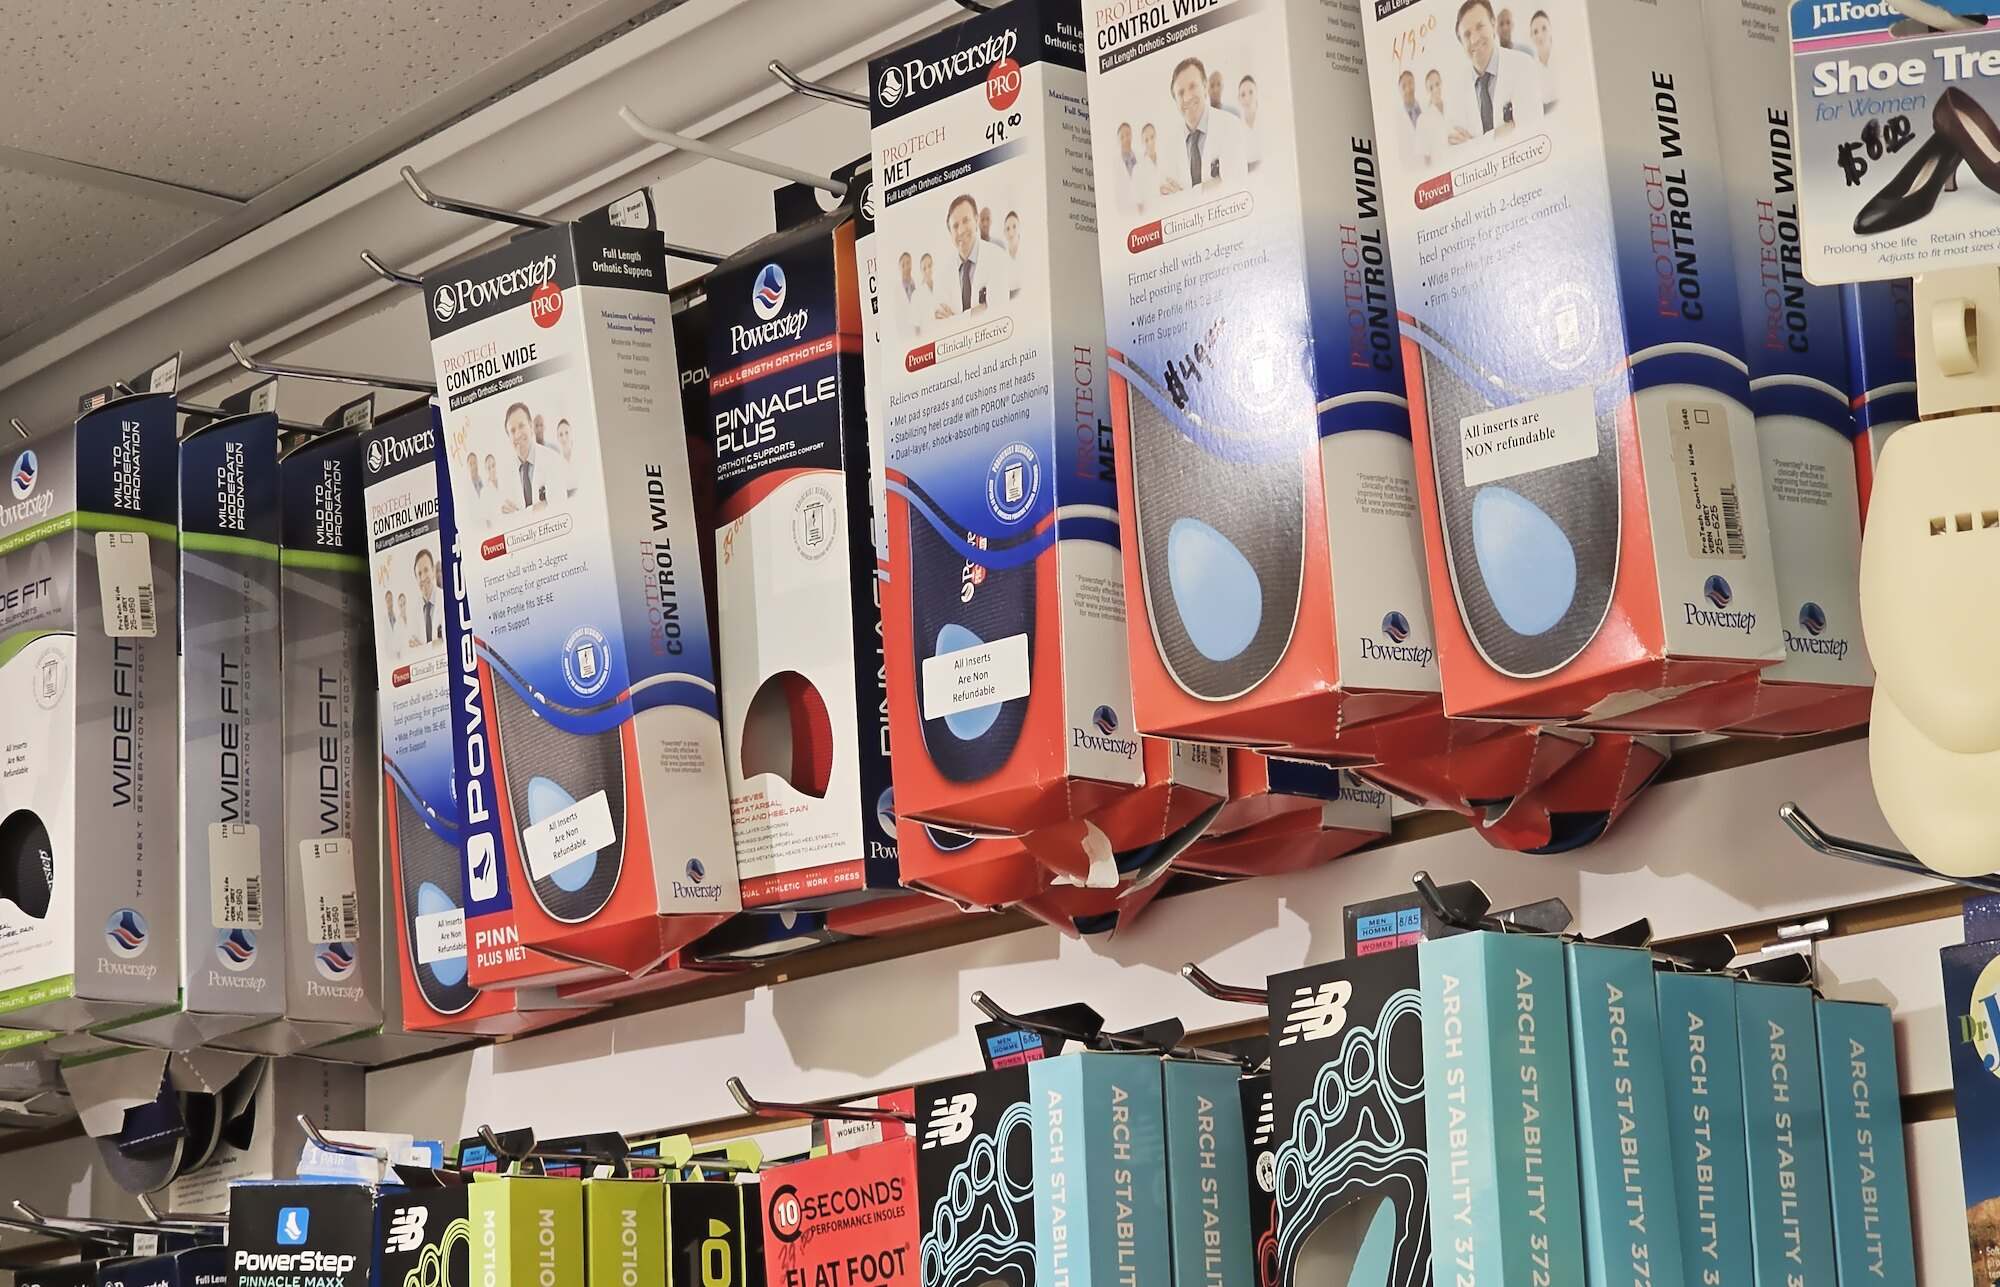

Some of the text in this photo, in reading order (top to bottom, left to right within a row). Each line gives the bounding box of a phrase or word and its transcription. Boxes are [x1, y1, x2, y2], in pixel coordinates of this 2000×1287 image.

[1098, 4, 1170, 51] CONTROL
[904, 28, 1018, 98] Powerstep
[1101, 24, 1198, 70] Full Length Orthotic Supports
[988, 70, 1020, 100] PRO
[1813, 46, 2000, 97] Shoe Tre
[1816, 95, 1926, 122] for Women
[882, 127, 946, 165] PROTECH
[884, 158, 912, 186] MET
[886, 163, 972, 204] Full Length Orthotic Supports
[1650, 70, 1703, 322] CONTROL WIDE
[602, 248, 641, 263] Full Length
[1351, 136, 1393, 373] CONTROL WIDE
[1642, 163, 1680, 319] PROTECH
[1823, 244, 1868, 255] Prolong
[1871, 240, 1898, 250] shoe
[1900, 237, 1918, 247] life
[1930, 229, 1966, 244] Retain
[1878, 243, 1994, 264] Adjusts to fit most sizes
[592, 261, 652, 278] Orthotic Supports
[1127, 239, 1245, 287] Firmer shell with 2-degree
[456, 255, 557, 314] Powerstep
[1339, 224, 1370, 369] PROTECH
[532, 293, 562, 318] PRO
[730, 309, 808, 355] Powerstep
[443, 341, 498, 372] PROTECH
[446, 343, 538, 392] CONTROL WIDE
[712, 340, 833, 389] FULL LENGTH ORTHOTICS
[908, 351, 934, 368] Proven
[936, 335, 973, 356] Clinically
[889, 349, 1038, 408] Relieves metatarsal, heel and arch pain
[715, 375, 836, 436] PINNACLE
[894, 371, 1035, 427] Met pad spreads and cushions met heads
[716, 418, 777, 458] PLUS
[895, 408, 1030, 461] Dual-layer, shock-absorbing cushioning
[1464, 412, 1540, 441] All inserts are
[1465, 427, 1556, 460] NON refundable
[122, 421, 131, 508] MODERATE
[132, 422, 141, 510] PRONATION
[717, 440, 796, 474] ORTHOTIC SUPPORTS
[112, 446, 122, 507] MILD TO
[226, 442, 236, 530] MODERATE
[236, 442, 244, 530] PRONATION
[1691, 472, 1701, 509] Control
[218, 467, 228, 528] MILD TO
[1703, 504, 1711, 527] GREY
[373, 498, 439, 536] CONTROL WIDE
[1698, 514, 1708, 554] ProTech
[1711, 505, 1724, 554] 25-625
[645, 464, 683, 657] CONTROL WIDE
[1683, 602, 1756, 635] Powerstep
[954, 653, 991, 670] All Inserts
[1360, 637, 1433, 668] Powerstep
[1782, 629, 1848, 661] Powerstep
[952, 685, 995, 703] Refundable
[958, 670, 989, 685] Are Non
[112, 637, 133, 808] WIDE FIT
[220, 652, 240, 823] WIDE FIT
[319, 668, 340, 836] WIDE FIT
[1073, 728, 1137, 760] Powerstep
[548, 811, 578, 832] All Inserts
[554, 826, 579, 845] Are Non
[552, 837, 587, 862] Refundable
[672, 882, 722, 901] Powerstep
[475, 923, 519, 949] PINN
[1362, 926, 1394, 936] HOMME
[1368, 917, 1387, 926] MEN
[477, 946, 529, 968] PLUS MET
[1361, 940, 1393, 951] WOMEN
[97, 958, 157, 979] Powerstep
[208, 970, 266, 992] Powerstep
[1958, 1014, 1990, 1045] Dr.
[1442, 973, 1475, 1287] ARCH STABILITY 372
[1516, 968, 1551, 1287] ARCH STABILITY 372
[1849, 1038, 1885, 1278] ARCH STABILITY
[777, 1177, 903, 1227] 10 SECONDS
[811, 1206, 905, 1235] PERFORMANCE INSOLES
[234, 1250, 356, 1276] PowerStep
[539, 1209, 556, 1287] MOTIO
[847, 1248, 906, 1286] FOOT
[238, 1276, 345, 1287] PINNACLE MAXX
